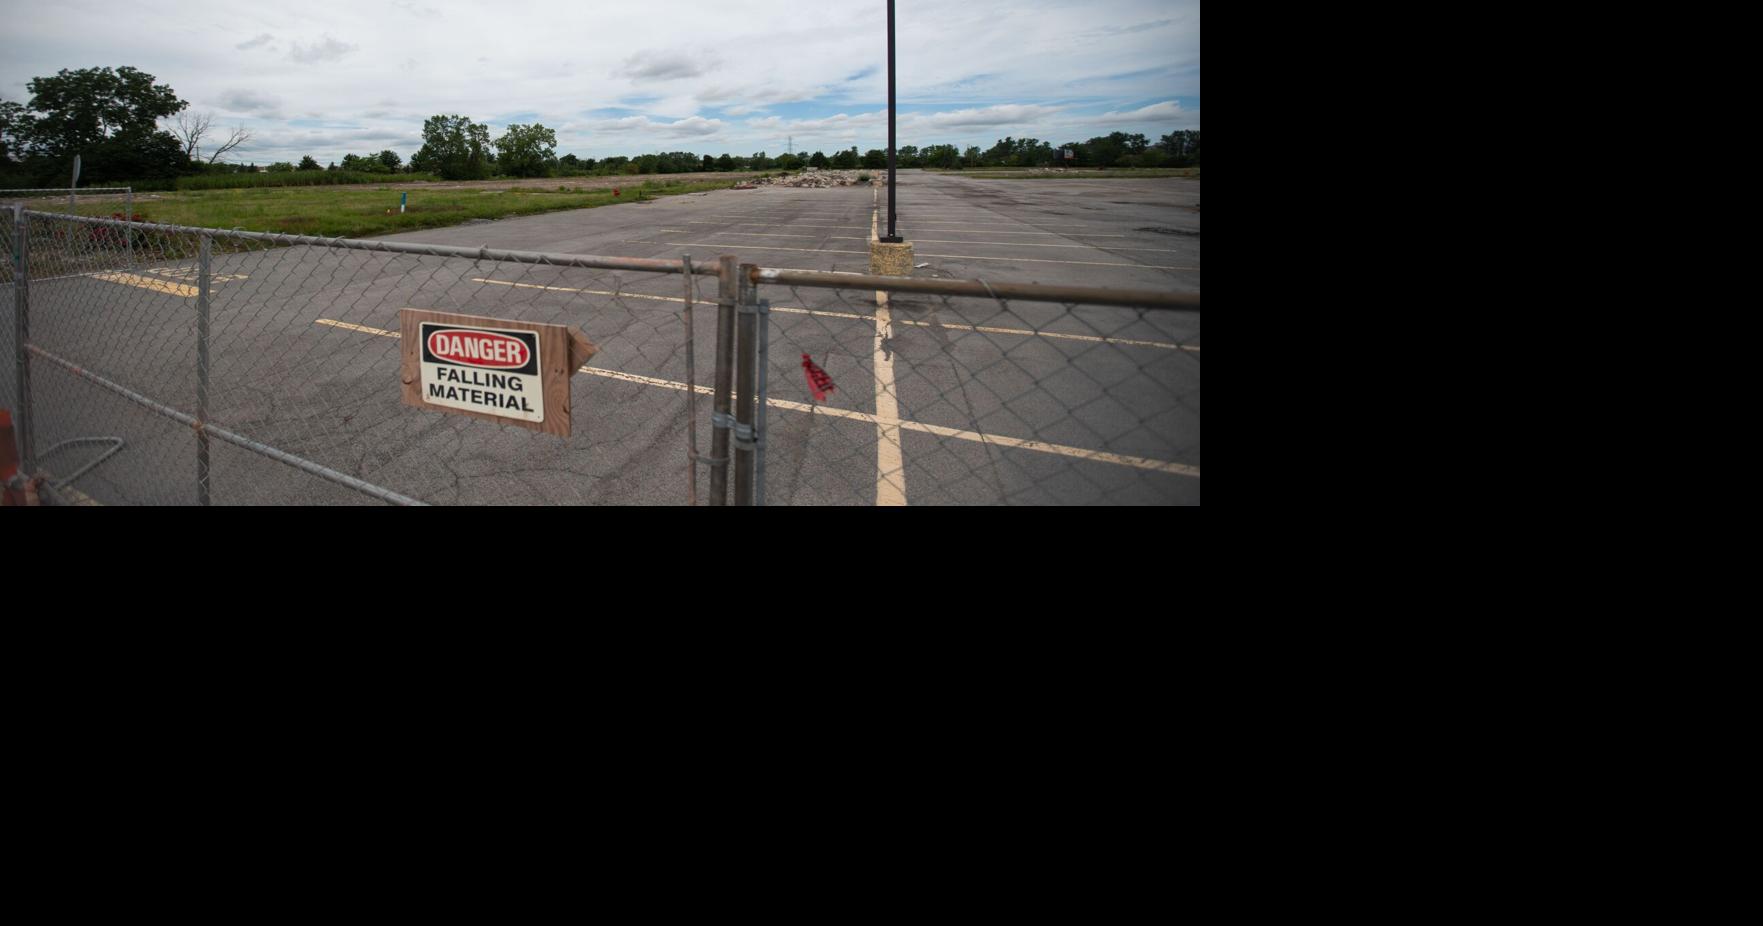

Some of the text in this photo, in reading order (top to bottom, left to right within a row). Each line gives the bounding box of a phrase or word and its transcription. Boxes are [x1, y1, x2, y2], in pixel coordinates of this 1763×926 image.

[436, 334, 522, 363] DANGER
[437, 368, 523, 392] FALLING
[429, 384, 534, 412] MATERIAL
